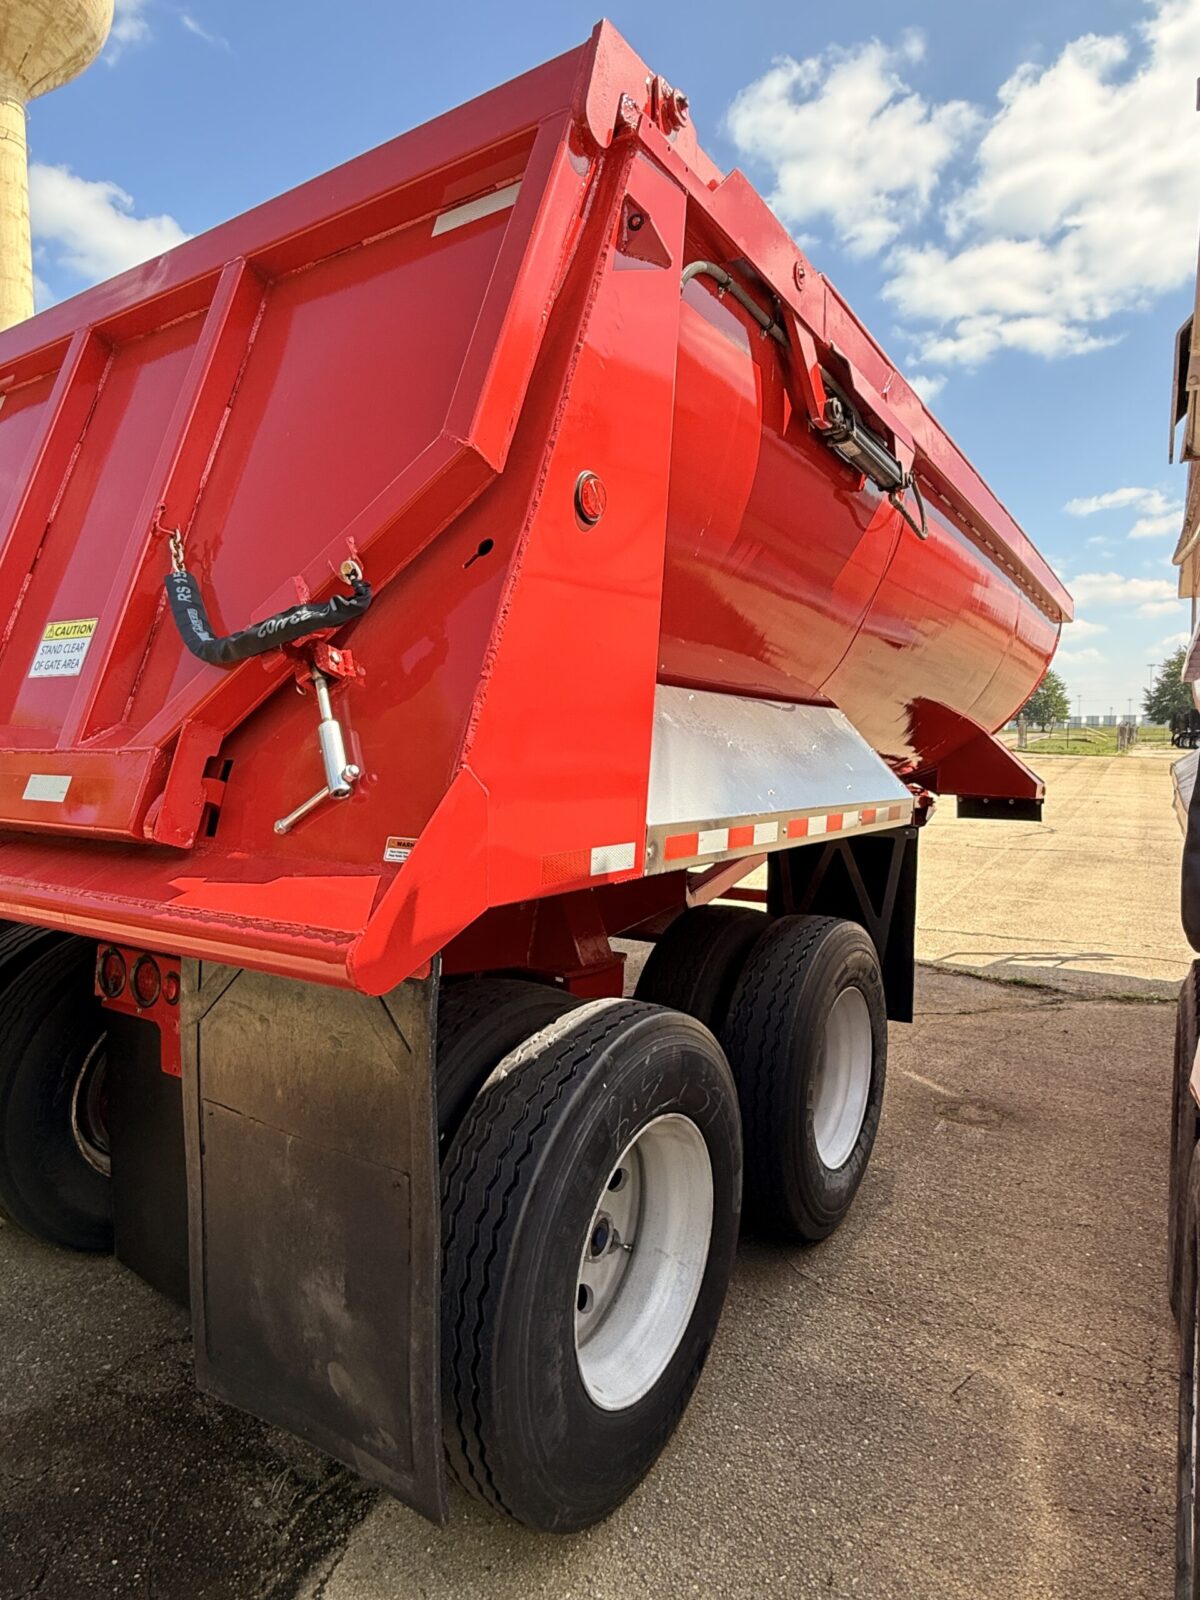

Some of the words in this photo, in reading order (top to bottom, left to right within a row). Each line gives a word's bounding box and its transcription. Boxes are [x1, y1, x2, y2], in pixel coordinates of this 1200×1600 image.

[177, 585, 192, 602] RS
[54, 623, 94, 637] CAUTION
[40, 644, 63, 655] STAND
[63, 642, 85, 654] CLEAR
[34, 660, 45, 671] OF
[45, 659, 62, 671] GATE
[61, 658, 80, 669] AREA
